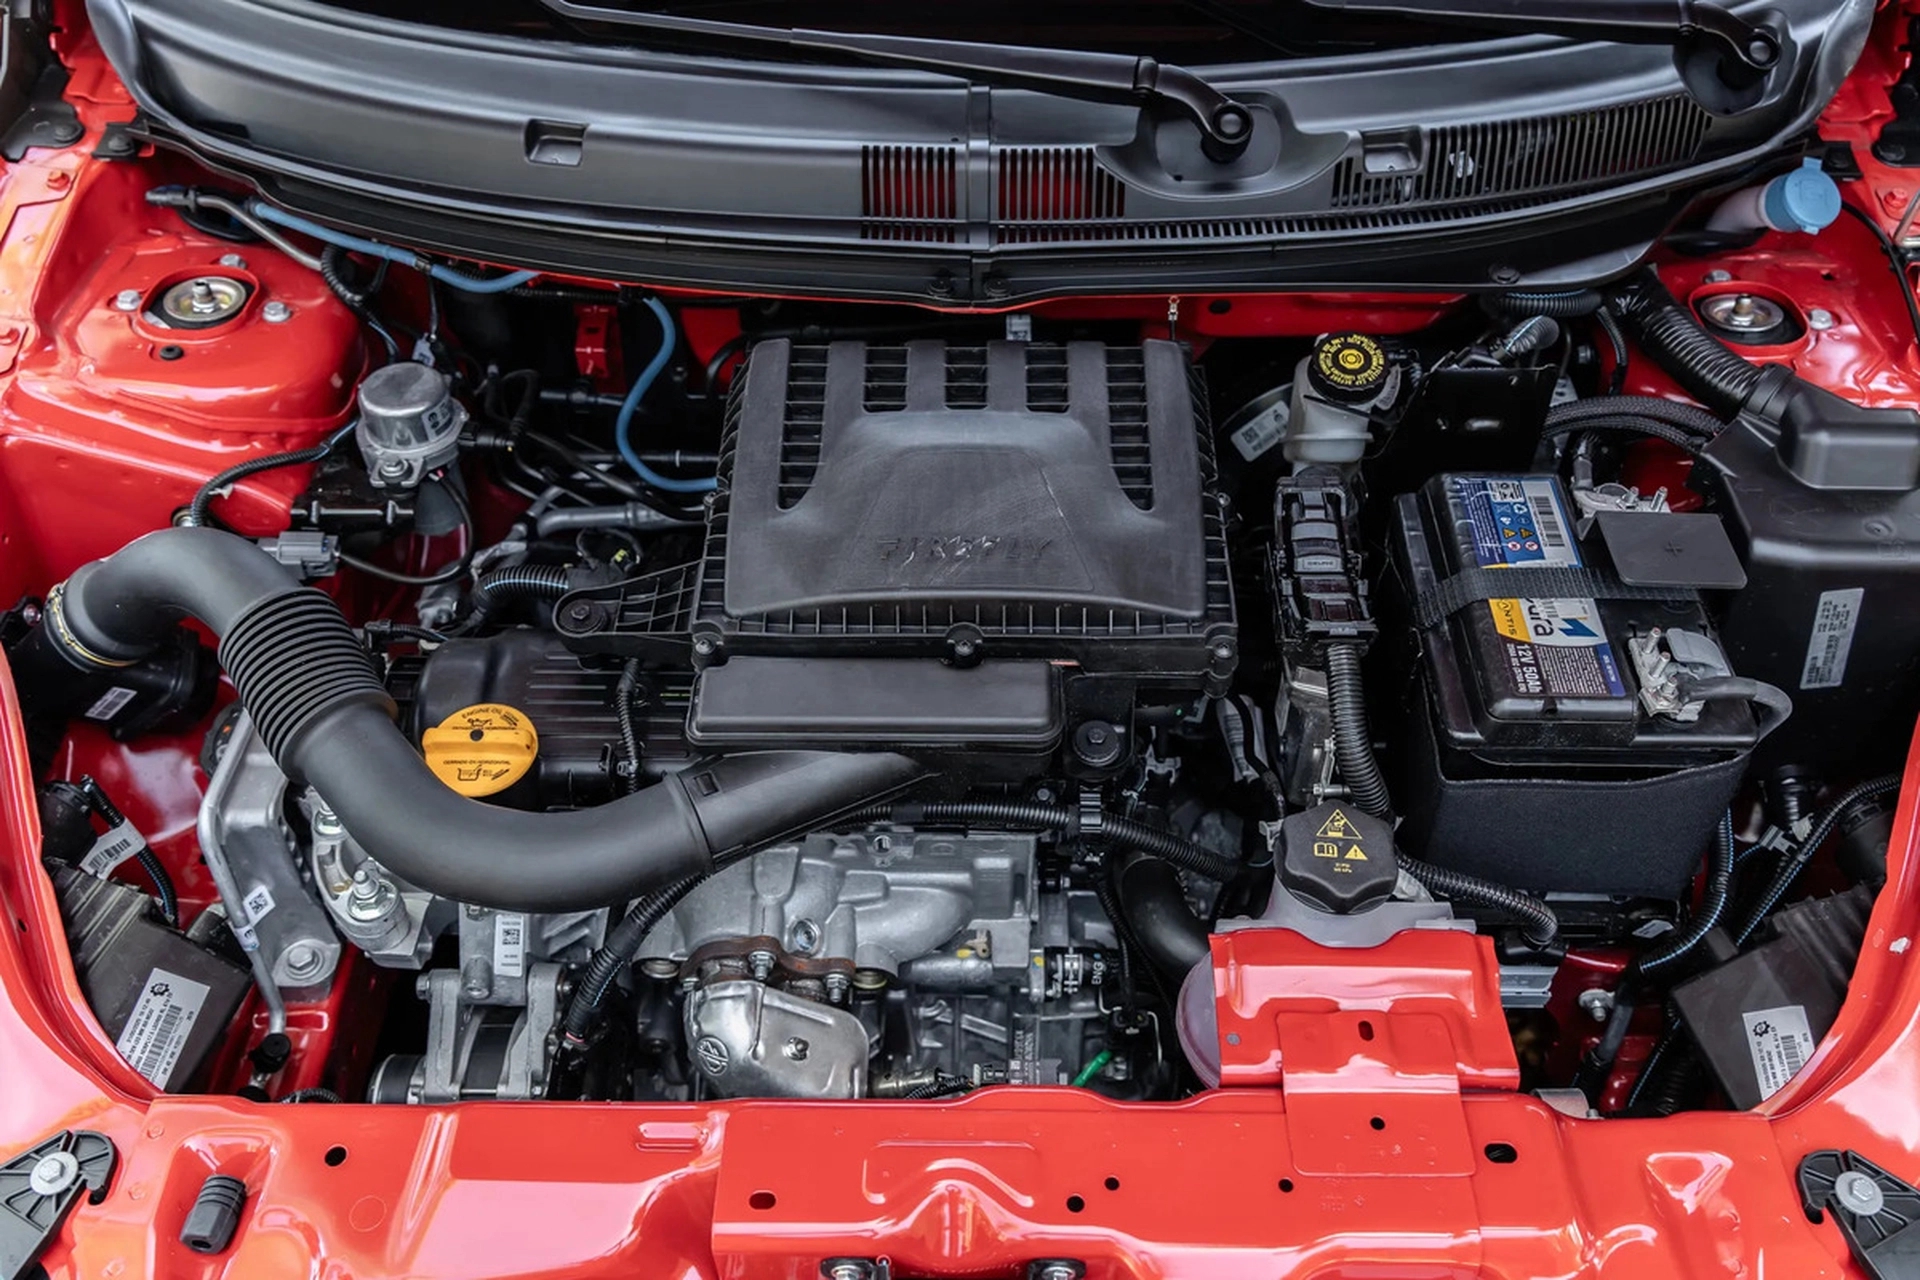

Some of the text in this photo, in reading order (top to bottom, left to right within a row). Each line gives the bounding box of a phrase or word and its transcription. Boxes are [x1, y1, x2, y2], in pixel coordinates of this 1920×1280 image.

[1516, 644, 1542, 693] 12V 50Ah
[462, 708, 490, 719] ENGINE
[1091, 961, 1105, 985] ENG
